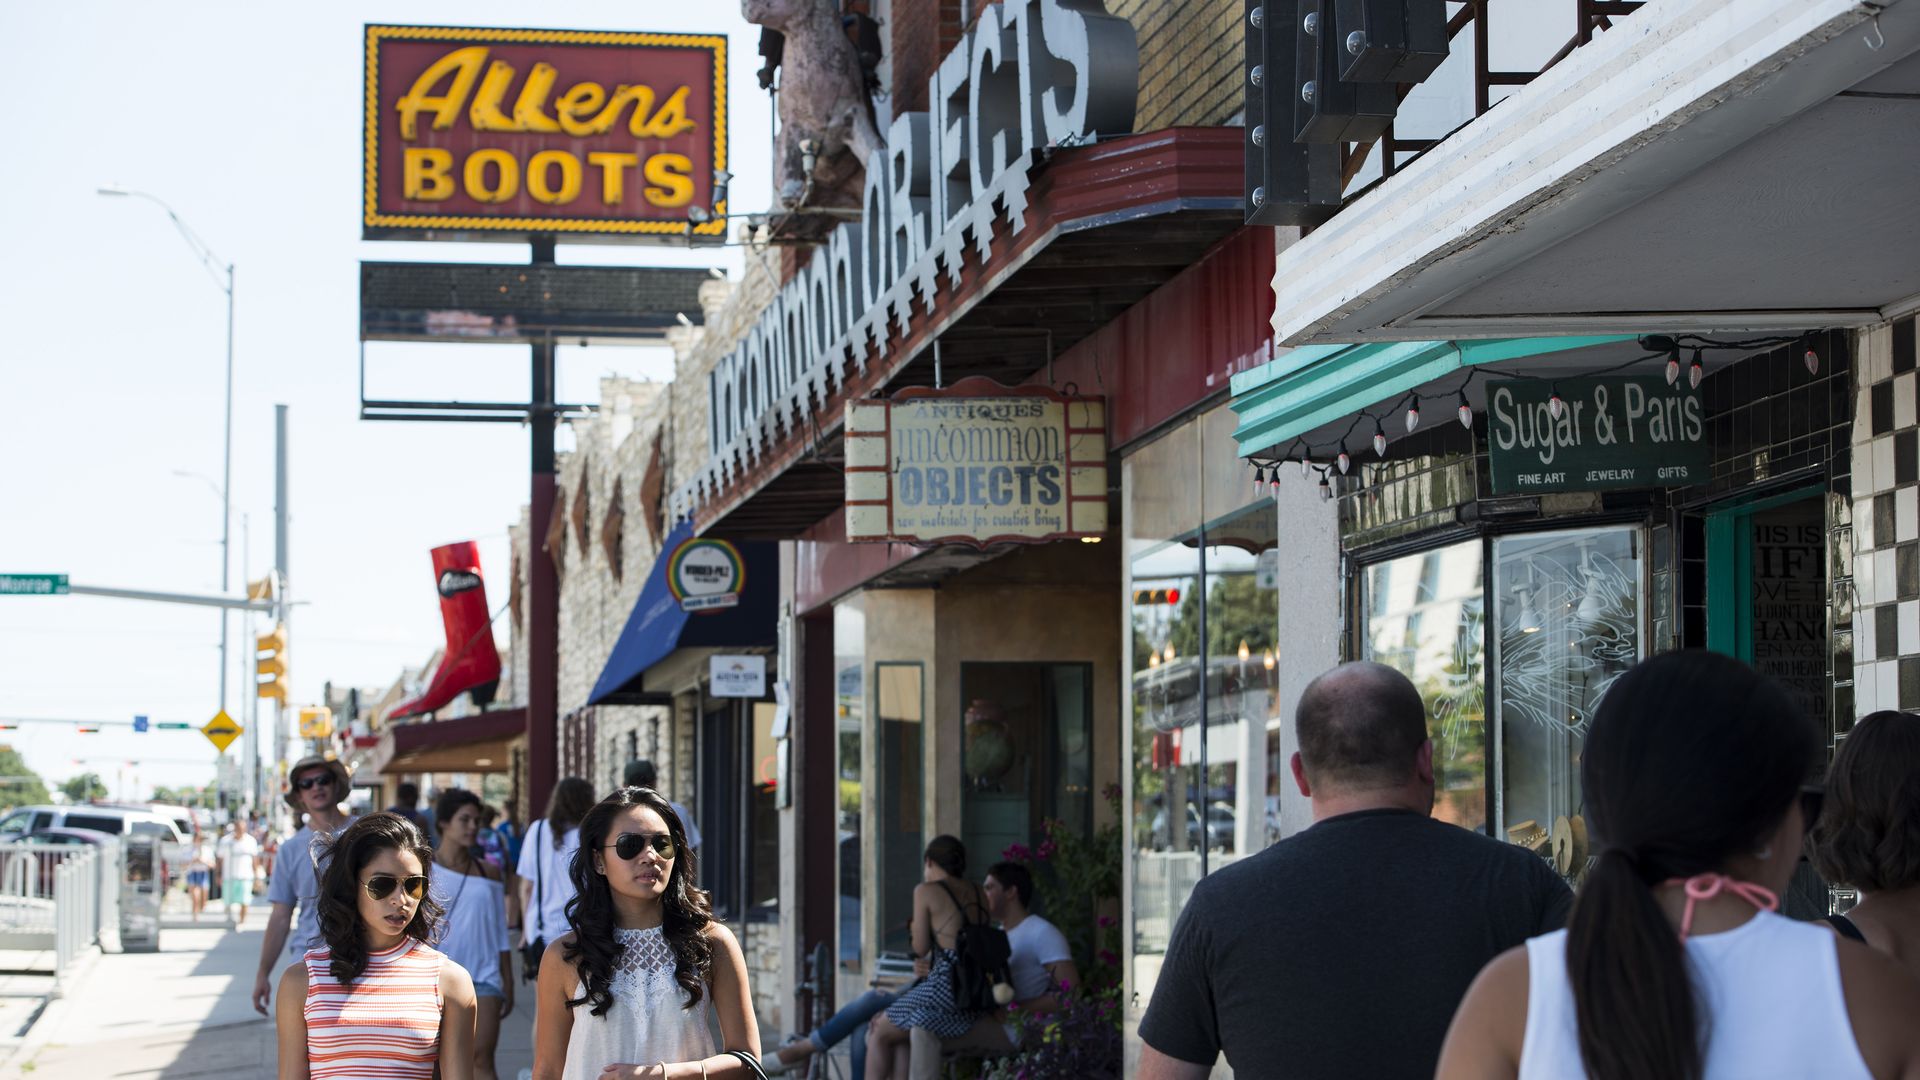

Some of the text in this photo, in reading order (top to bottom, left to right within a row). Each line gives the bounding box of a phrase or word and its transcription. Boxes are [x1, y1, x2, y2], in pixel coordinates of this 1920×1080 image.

[395, 46, 698, 141] Allens
[861, 0, 1090, 316] OBJECTS
[403, 147, 696, 208] BOOTS
[913, 404, 1044, 420] ANTIQUES
[1494, 381, 1702, 465] Sugar & Paris
[895, 425, 1061, 463] uncommon
[899, 465, 1062, 507] OBJECTS
[1517, 466, 1688, 485] FINE ART JEWELRY GIFTS
[920, 510, 967, 528] materials
[973, 509, 988, 533] for
[992, 510, 1030, 528] creative
[1806, 604, 1826, 619] LIK
[1792, 660, 1825, 676] HEAR
